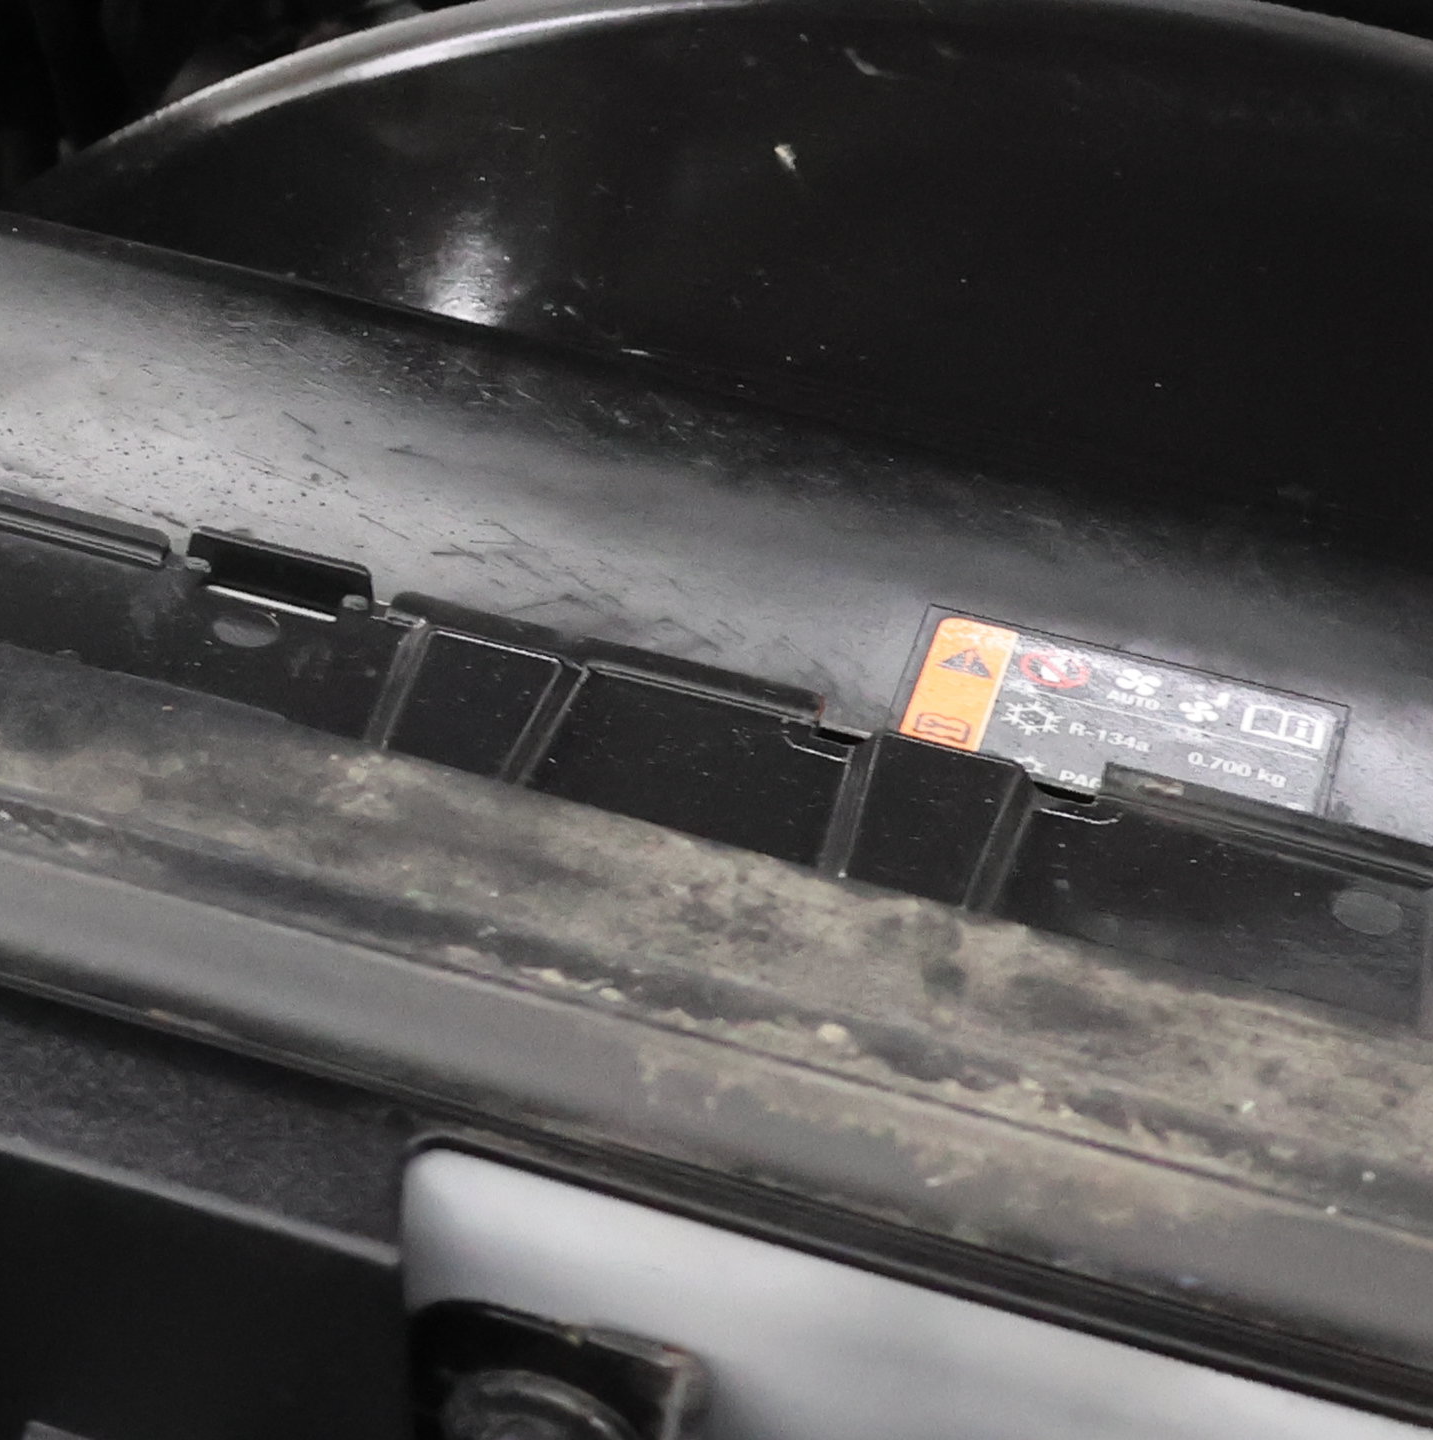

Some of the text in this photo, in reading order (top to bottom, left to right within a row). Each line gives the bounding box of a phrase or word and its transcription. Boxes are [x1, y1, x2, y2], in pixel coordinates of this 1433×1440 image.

[1105, 691, 1161, 711] AUTO
[1067, 722, 1288, 789] R-134a 0.700 kg
